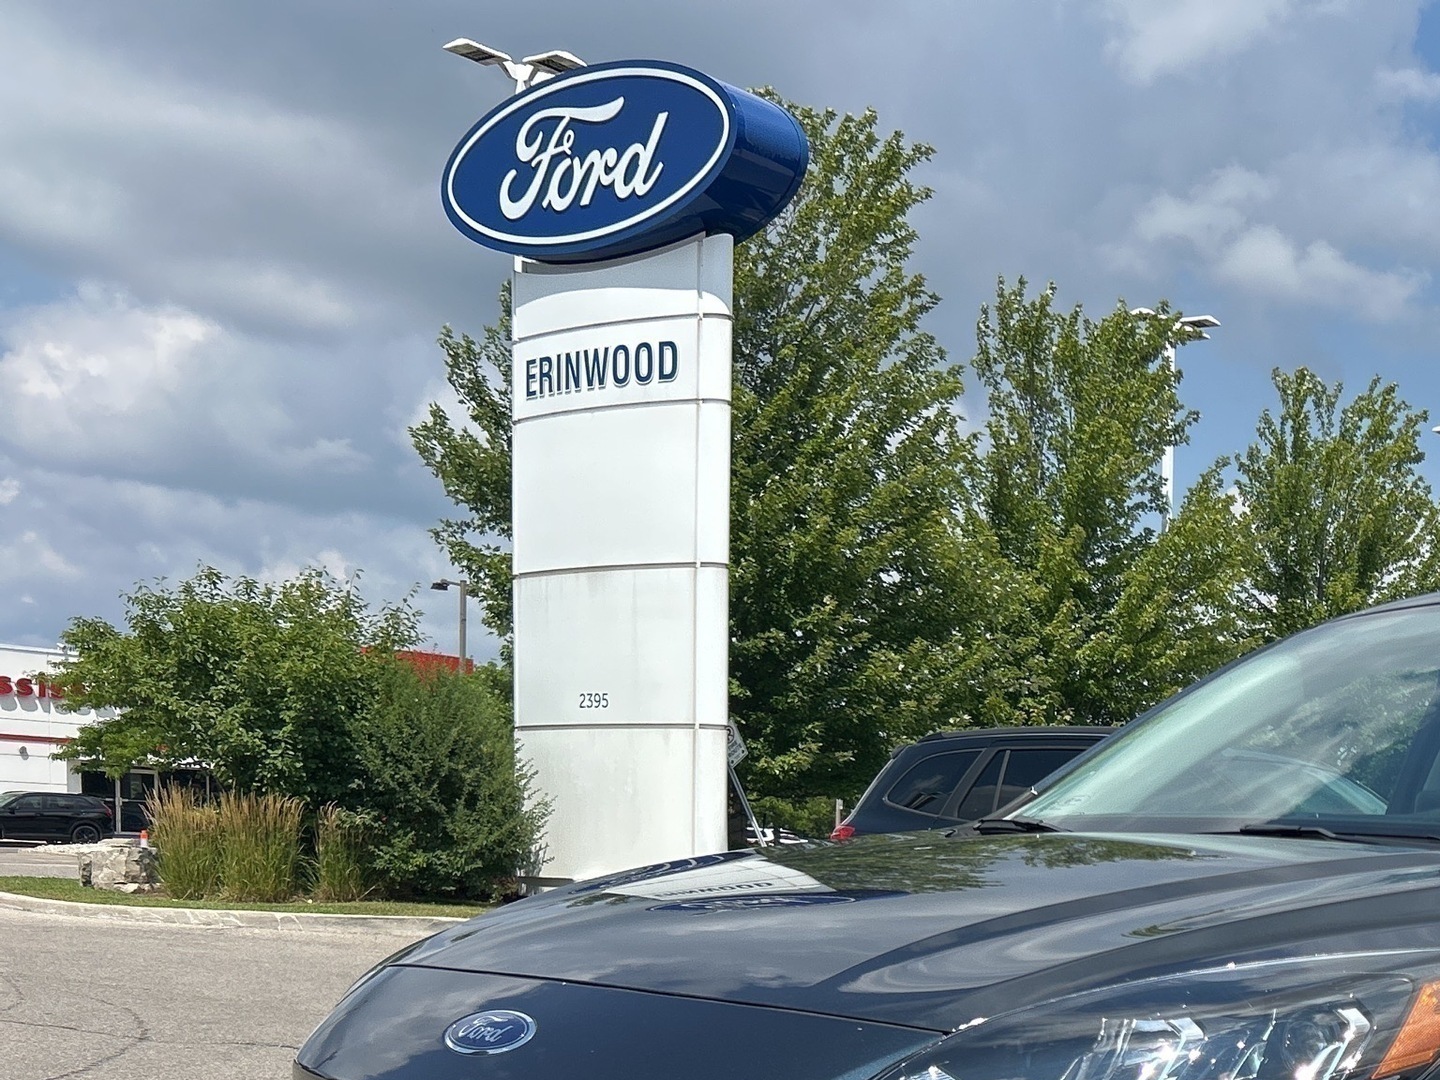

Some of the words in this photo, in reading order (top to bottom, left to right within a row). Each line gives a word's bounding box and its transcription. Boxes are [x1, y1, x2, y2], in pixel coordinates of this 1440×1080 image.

[500, 96, 669, 219] Ford
[526, 341, 679, 398] ERINWOOD
[579, 693, 609, 709] 2395
[458, 1015, 514, 1042] Ford
